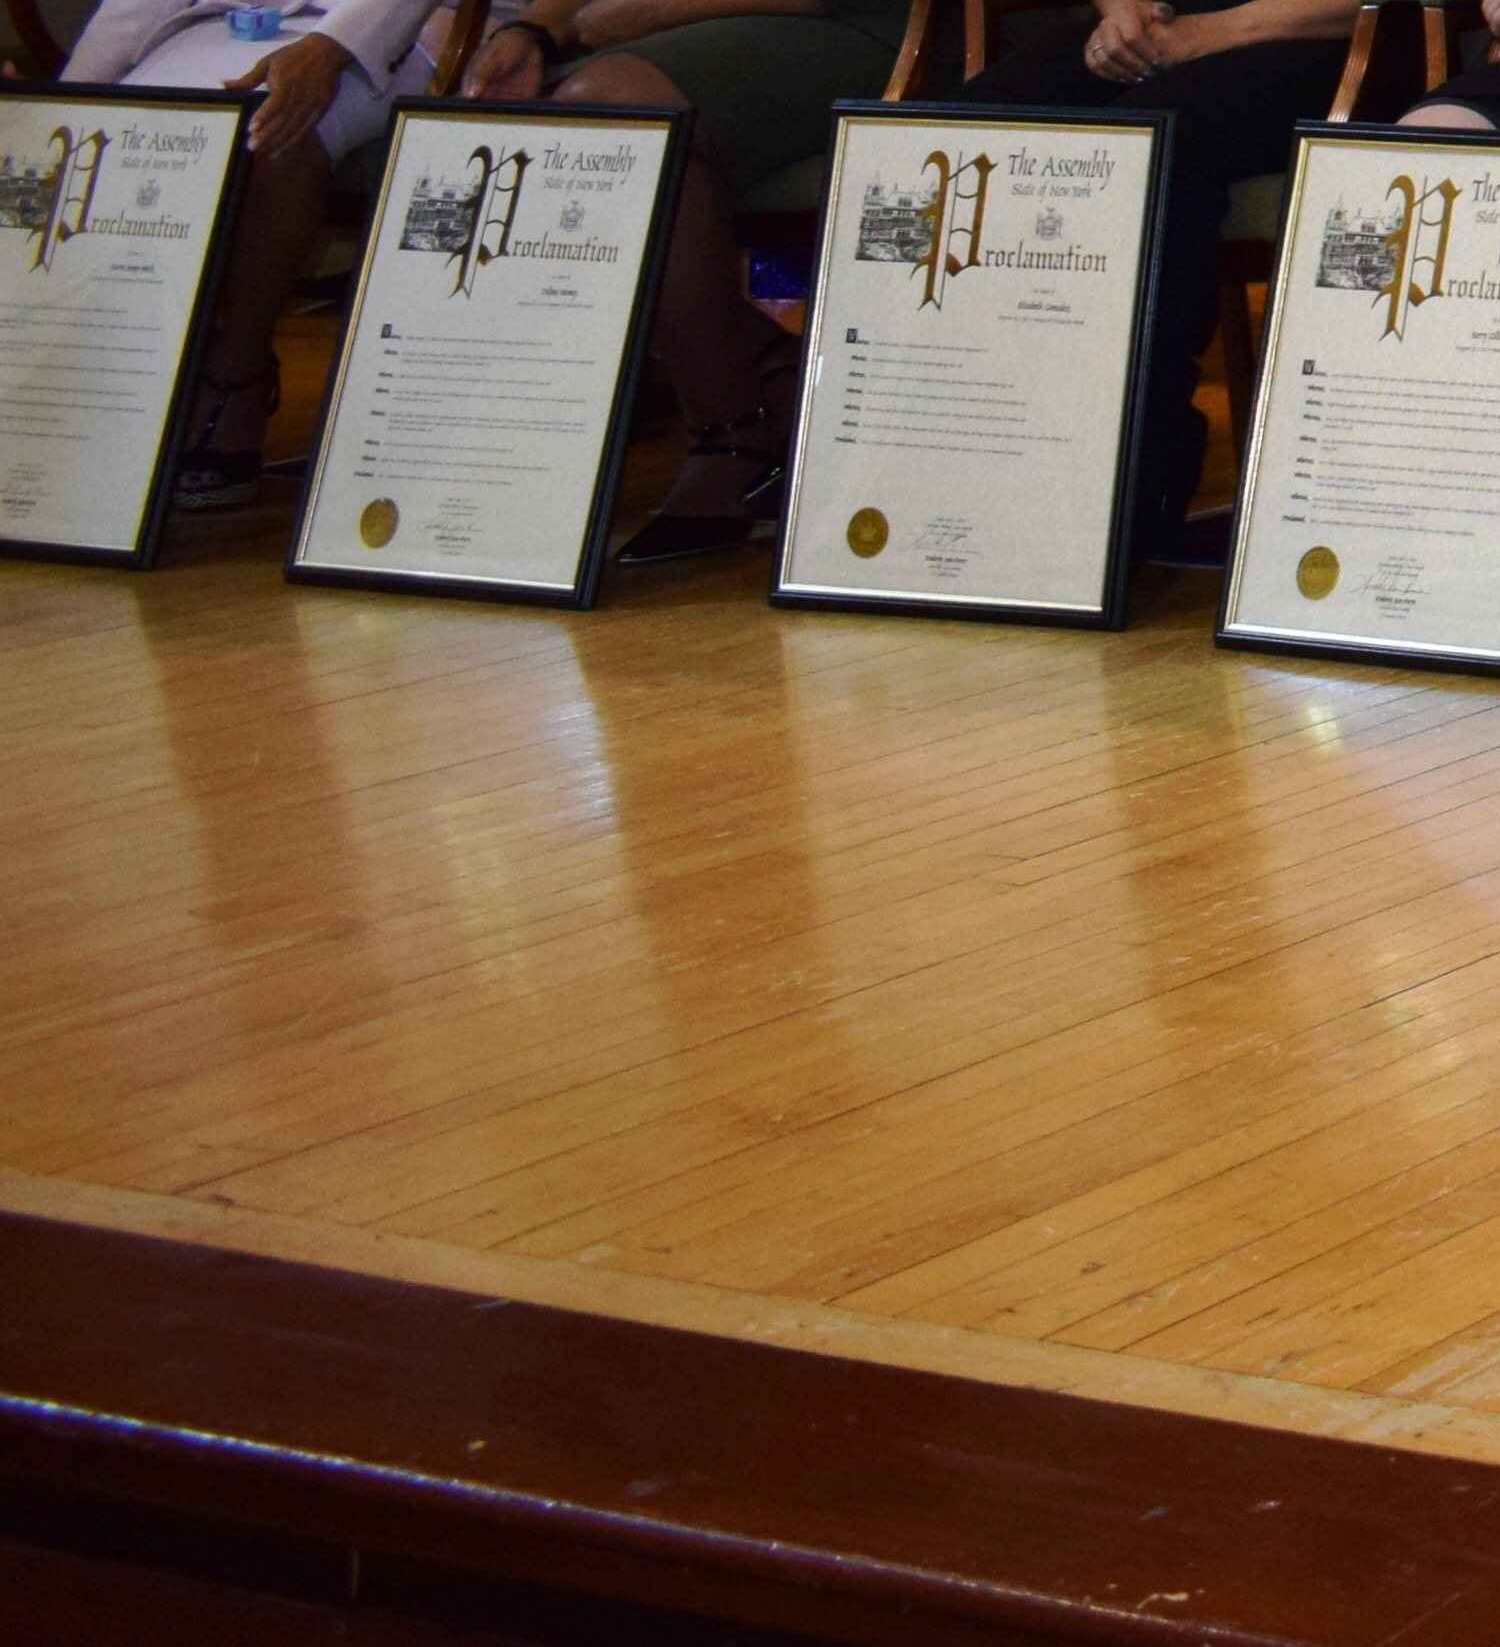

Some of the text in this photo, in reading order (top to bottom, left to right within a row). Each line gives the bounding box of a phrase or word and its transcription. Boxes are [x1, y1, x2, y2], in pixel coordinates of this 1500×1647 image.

[121, 123, 209, 165] The Assembly
[542, 142, 637, 186] The Assembly
[1008, 147, 1116, 191] The Assembly
[1472, 172, 1500, 202] The
[26, 125, 192, 274] Proclamation
[1012, 181, 1093, 203] State of New York
[445, 145, 621, 300] Proclamation
[908, 149, 1109, 313] Proclamation
[1475, 210, 1499, 225] State
